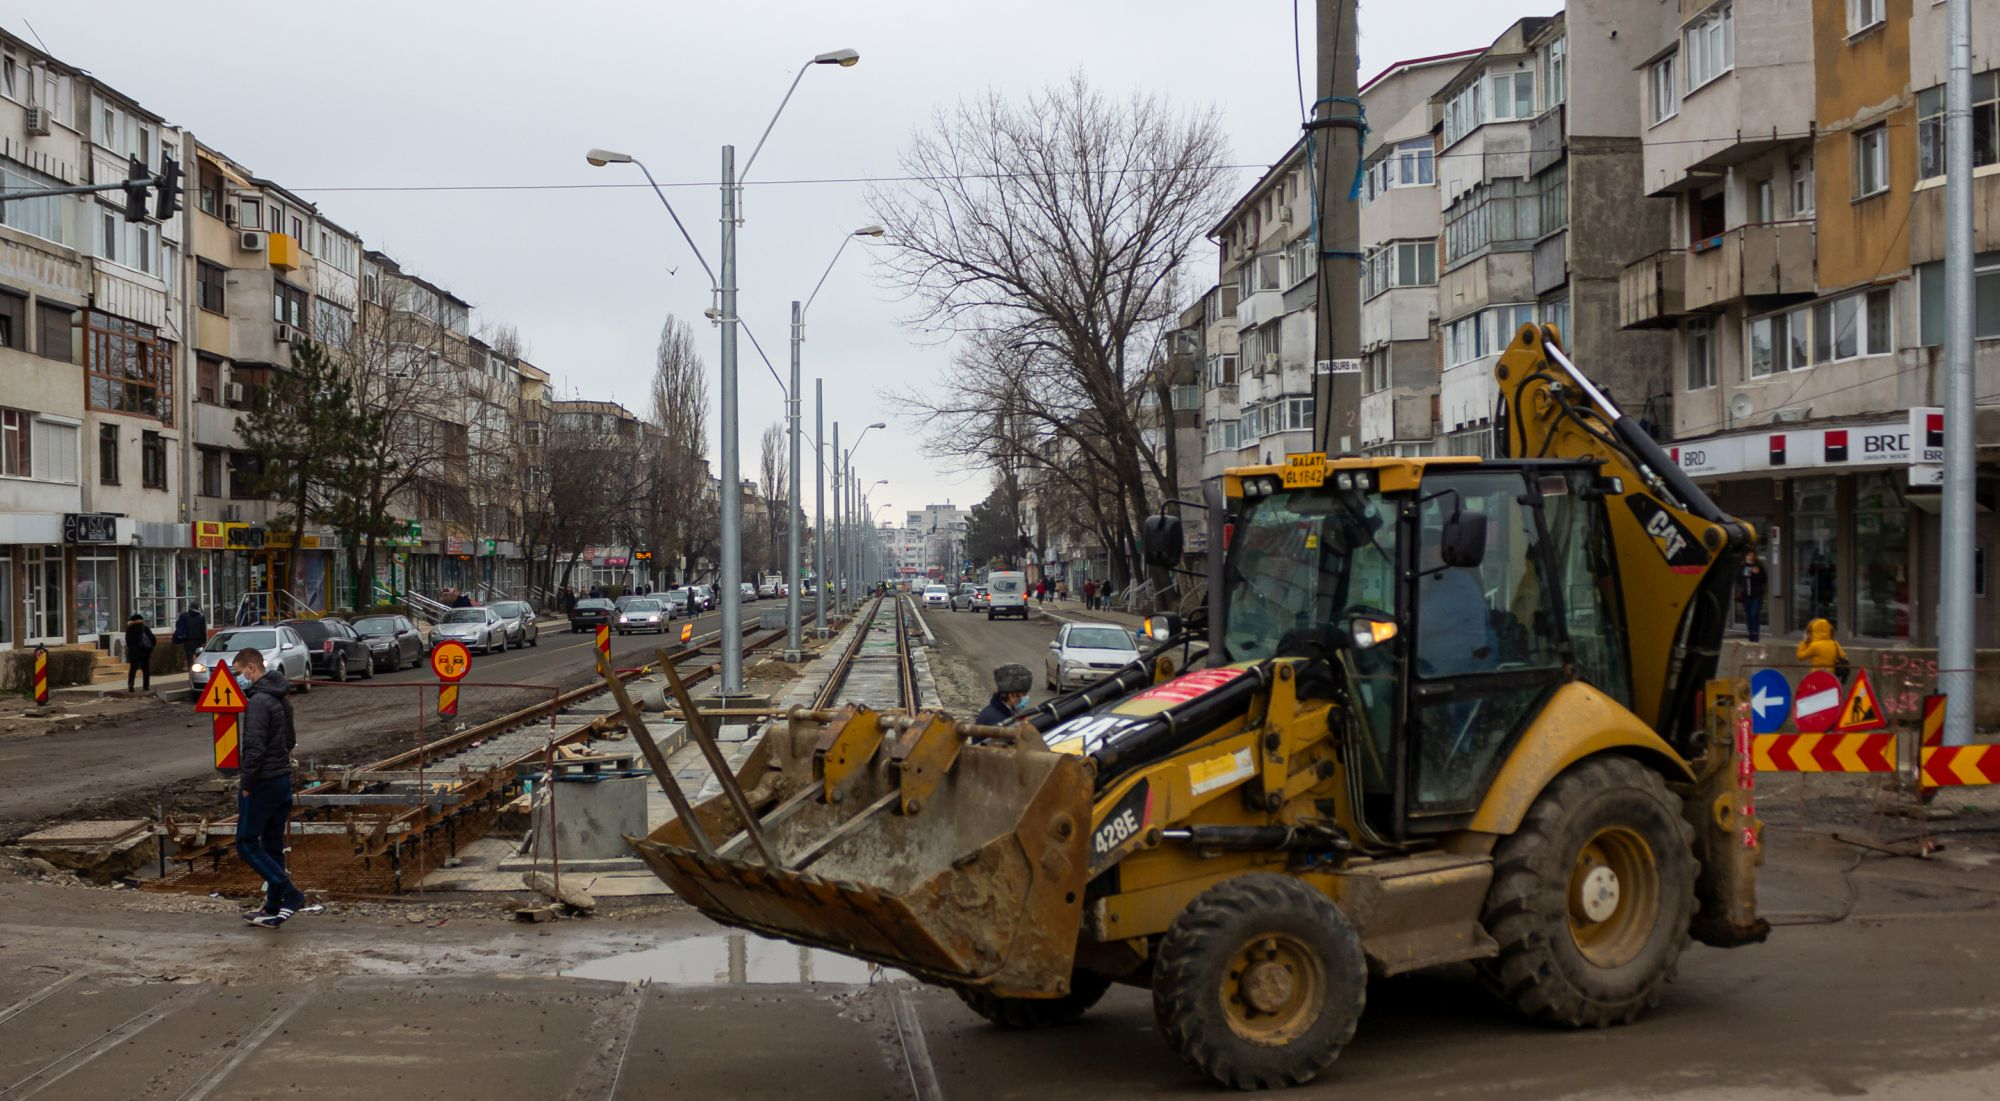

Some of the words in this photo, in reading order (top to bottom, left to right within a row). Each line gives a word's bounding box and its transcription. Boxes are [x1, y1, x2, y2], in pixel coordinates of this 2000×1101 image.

[1319, 361, 1350, 371] TRASURB
[1685, 451, 1706, 466] BRD
[1924, 450, 1943, 460] BR
[1646, 510, 1688, 561] CAT
[1042, 715, 1149, 757] CAT
[1095, 808, 1139, 854] 428E
